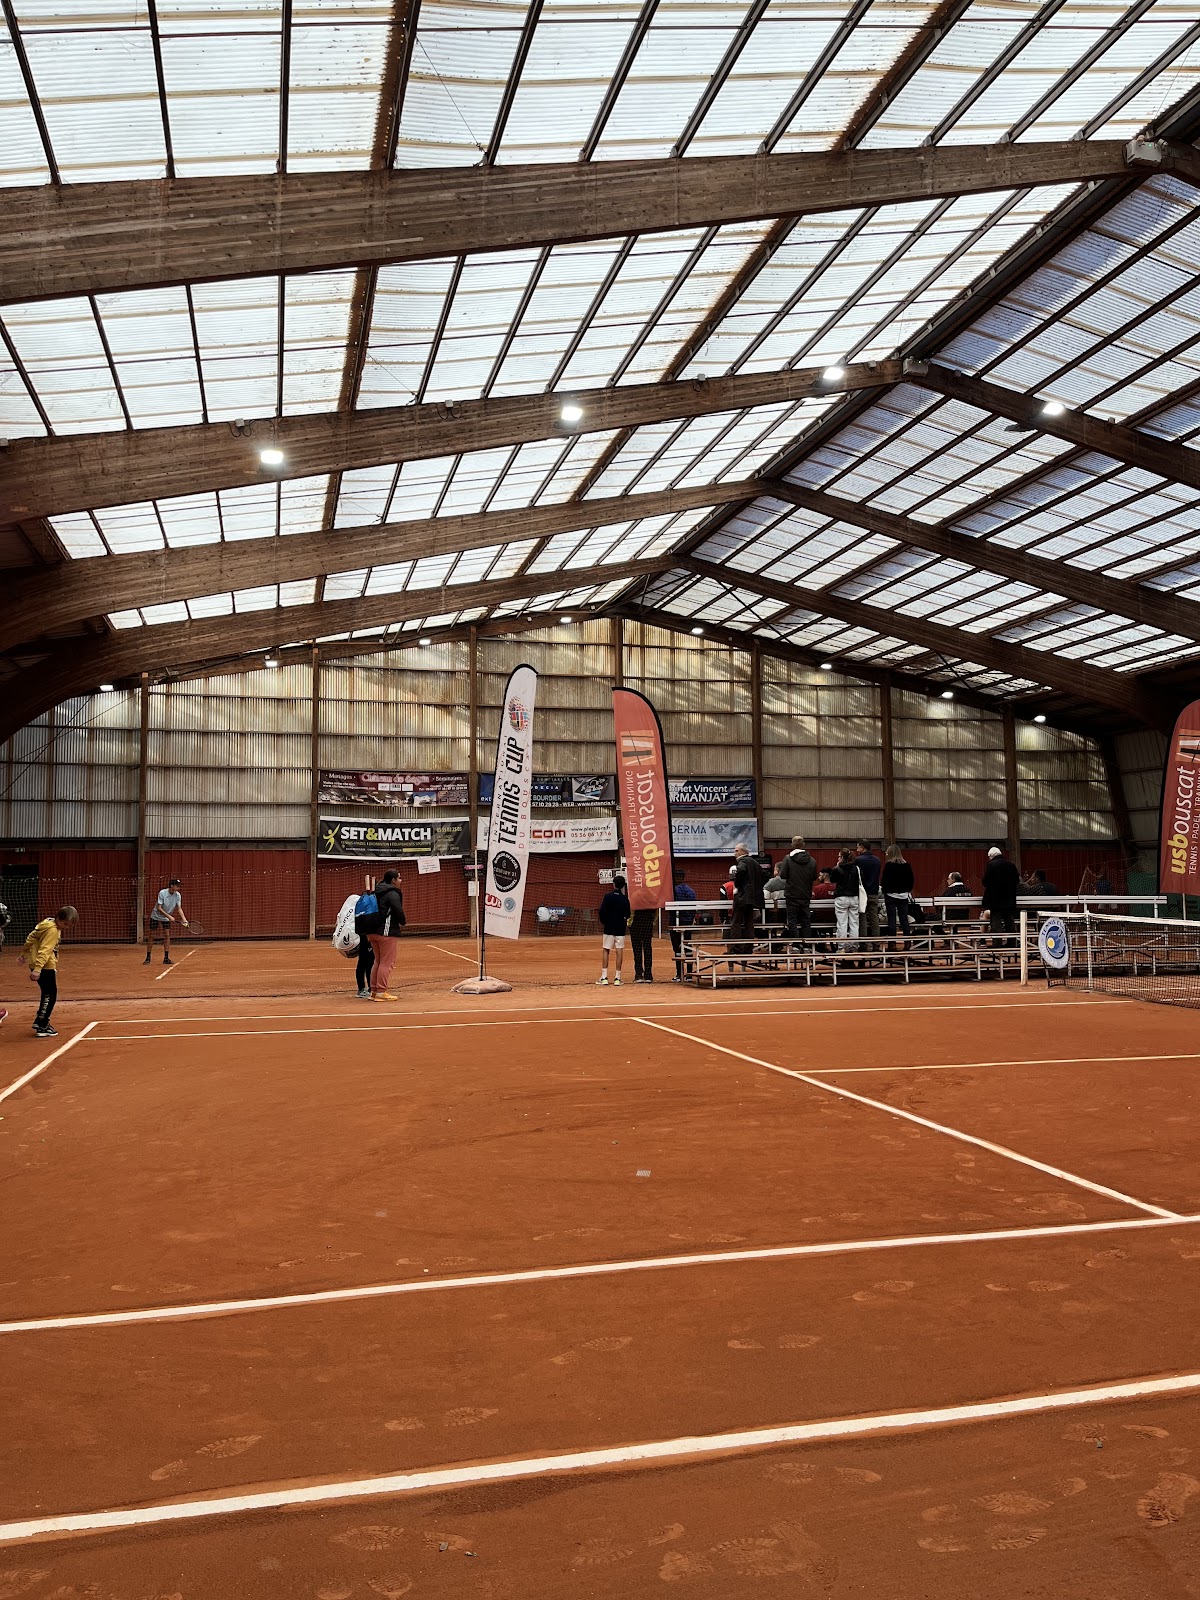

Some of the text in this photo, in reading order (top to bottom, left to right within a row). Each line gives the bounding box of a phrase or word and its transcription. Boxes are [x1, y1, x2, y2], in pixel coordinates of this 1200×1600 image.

[498, 736, 525, 844] TENNIS CUP
[518, 743, 530, 849] DU BOUSCAT
[532, 794, 562, 802] BOURDIER
[693, 784, 728, 793] Vincent
[340, 826, 432, 841] SET&MATCH
[1167, 765, 1196, 875] usbouscat
[1191, 814, 1200, 839] PADEL
[1188, 845, 1198, 875] TENNIS
